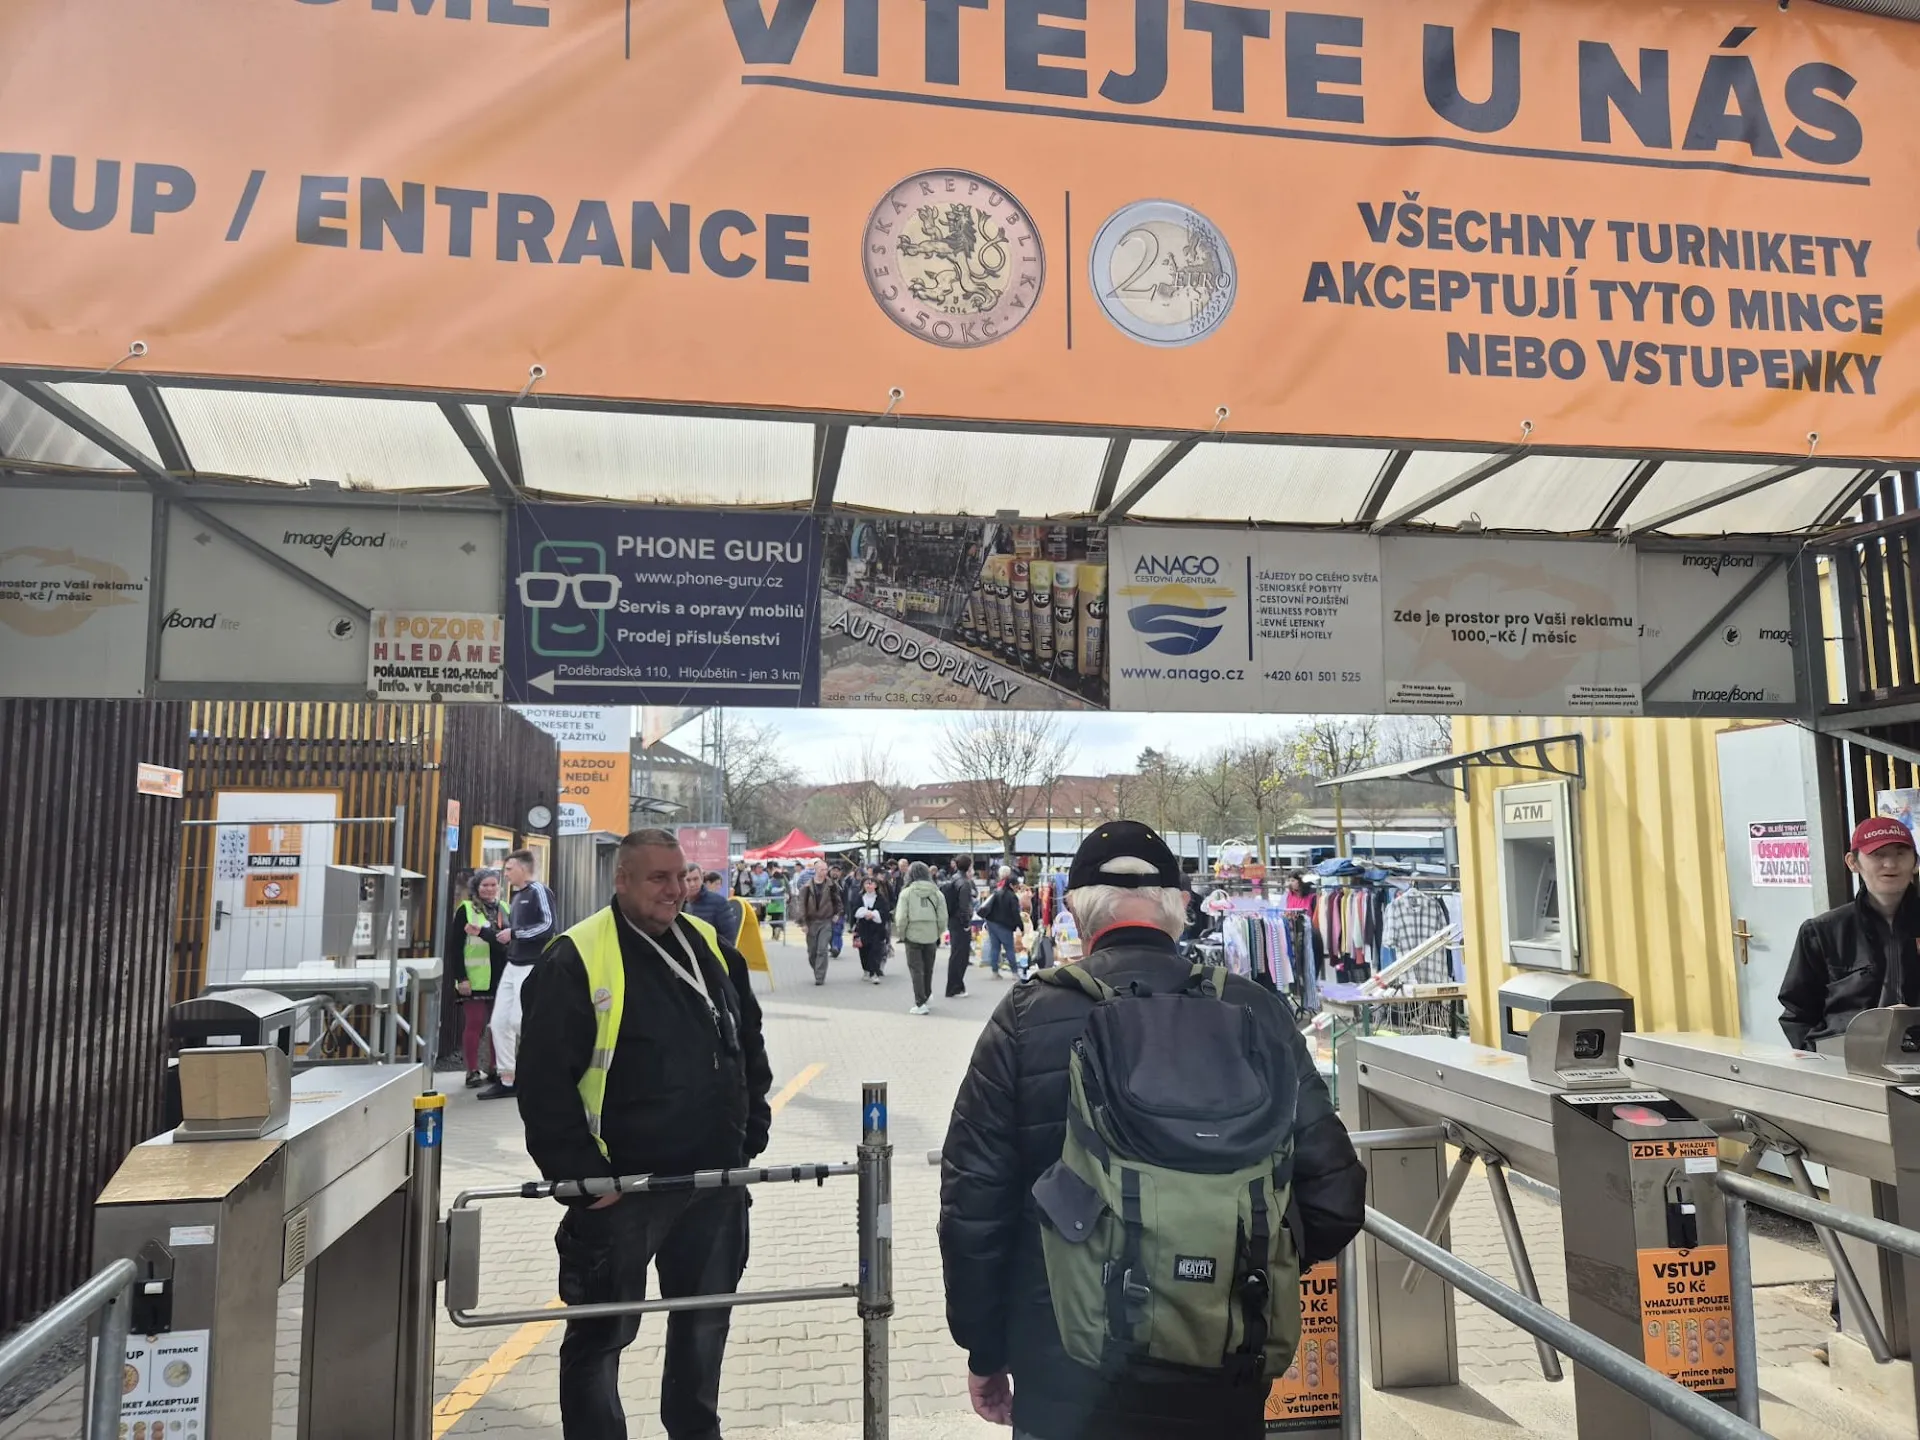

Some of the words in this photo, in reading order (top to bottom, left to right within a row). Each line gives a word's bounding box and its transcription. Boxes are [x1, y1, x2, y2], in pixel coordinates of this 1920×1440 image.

[1423, 23, 1521, 133] U
[1578, 27, 1863, 165] NÁS
[226, 170, 267, 242] /
[295, 176, 810, 282] ENTRANCE
[1356, 190, 1595, 256] VŠECHNY
[1607, 220, 1872, 278] TURNIKETY
[1171, 269, 1233, 291] EURO
[1302, 261, 1579, 321] AKCEPTUJÍ
[1590, 279, 1715, 328] TYTO
[1728, 287, 1884, 336] MINCE
[1446, 331, 1586, 381] NEBO
[1596, 339, 1882, 395] VSTUPENKY
[617, 535, 715, 560] PHONE
[724, 538, 803, 564] GURU
[1134, 554, 1220, 577] ANAGO
[635, 571, 784, 590] www.phone-guru.cz
[1135, 575, 1174, 584] CESTOVNÍ
[1175, 576, 1217, 585] AGENTURA
[1299, 573, 1313, 583] DO
[1315, 571, 1350, 583] CELÉHO
[1352, 573, 1379, 584] SVĚTA
[40, 581, 61, 592] pro
[93, 581, 143, 591] reklamu
[1309, 584, 1342, 594] POBYTY
[1033, 593, 1050, 604] K2
[618, 600, 671, 615] Servis
[675, 604, 685, 615] a
[689, 605, 745, 620] opravy
[750, 603, 804, 619] mobilů
[1055, 607, 1073, 618] K2
[1304, 607, 1338, 618] POBYTY
[1289, 619, 1326, 629] LETENKY
[1393, 610, 1422, 623] Zde
[1425, 610, 1440, 627] je
[1445, 612, 1501, 628] prostor
[1504, 615, 1530, 628] pro
[1533, 613, 1567, 626] Vaši
[1570, 613, 1634, 628] reklamu
[394, 616, 485, 641] POZOR
[1300, 630, 1333, 641] HOTELY
[617, 628, 672, 647] Prodej
[676, 630, 780, 649] příslušenství
[1450, 628, 1518, 645] 1000,-Kč
[1520, 628, 1528, 646] /
[1532, 630, 1577, 643] měsíc
[373, 641, 501, 663] HLEDÁME
[829, 611, 1020, 704] AUTODOPLŇKY
[373, 664, 439, 679] POŘADATELE
[558, 664, 642, 678] Poděbradská
[646, 666, 671, 681] 110,
[748, 668, 768, 683] jen
[771, 669, 779, 680] 3
[782, 669, 801, 681] km
[1121, 667, 1245, 684] www.anago.cz
[1263, 671, 1292, 682] +420
[1294, 671, 1314, 682] 601
[1317, 672, 1338, 682] 501
[1341, 672, 1362, 683] 525
[827, 692, 846, 702] zde
[848, 693, 861, 702] na
[584, 721, 594, 730] SI
[563, 756, 616, 769] KAŽDOU
[1513, 805, 1544, 822] ATM
[1864, 828, 1906, 839] LEGOLAND
[1634, 1145, 1664, 1158] ZDE
[1679, 1141, 1716, 1149] VHAZUJTE
[1680, 1148, 1709, 1157] MINCE
[1178, 1262, 1213, 1276] MEATFLY
[1653, 1260, 1716, 1279] VSTUP
[1667, 1282, 1685, 1295] 50
[1689, 1279, 1706, 1293] Kč
[1311, 1298, 1328, 1312] Kč
[1645, 1297, 1695, 1309] VHAZUJTE
[1697, 1295, 1729, 1306] POUZE
[157, 1346, 199, 1356] ENTRANCE
[1681, 1367, 1710, 1378] mince
[1711, 1366, 1734, 1376] nebo
[145, 1396, 200, 1409] AKCEPTUJE
[1298, 1391, 1330, 1402] mince
